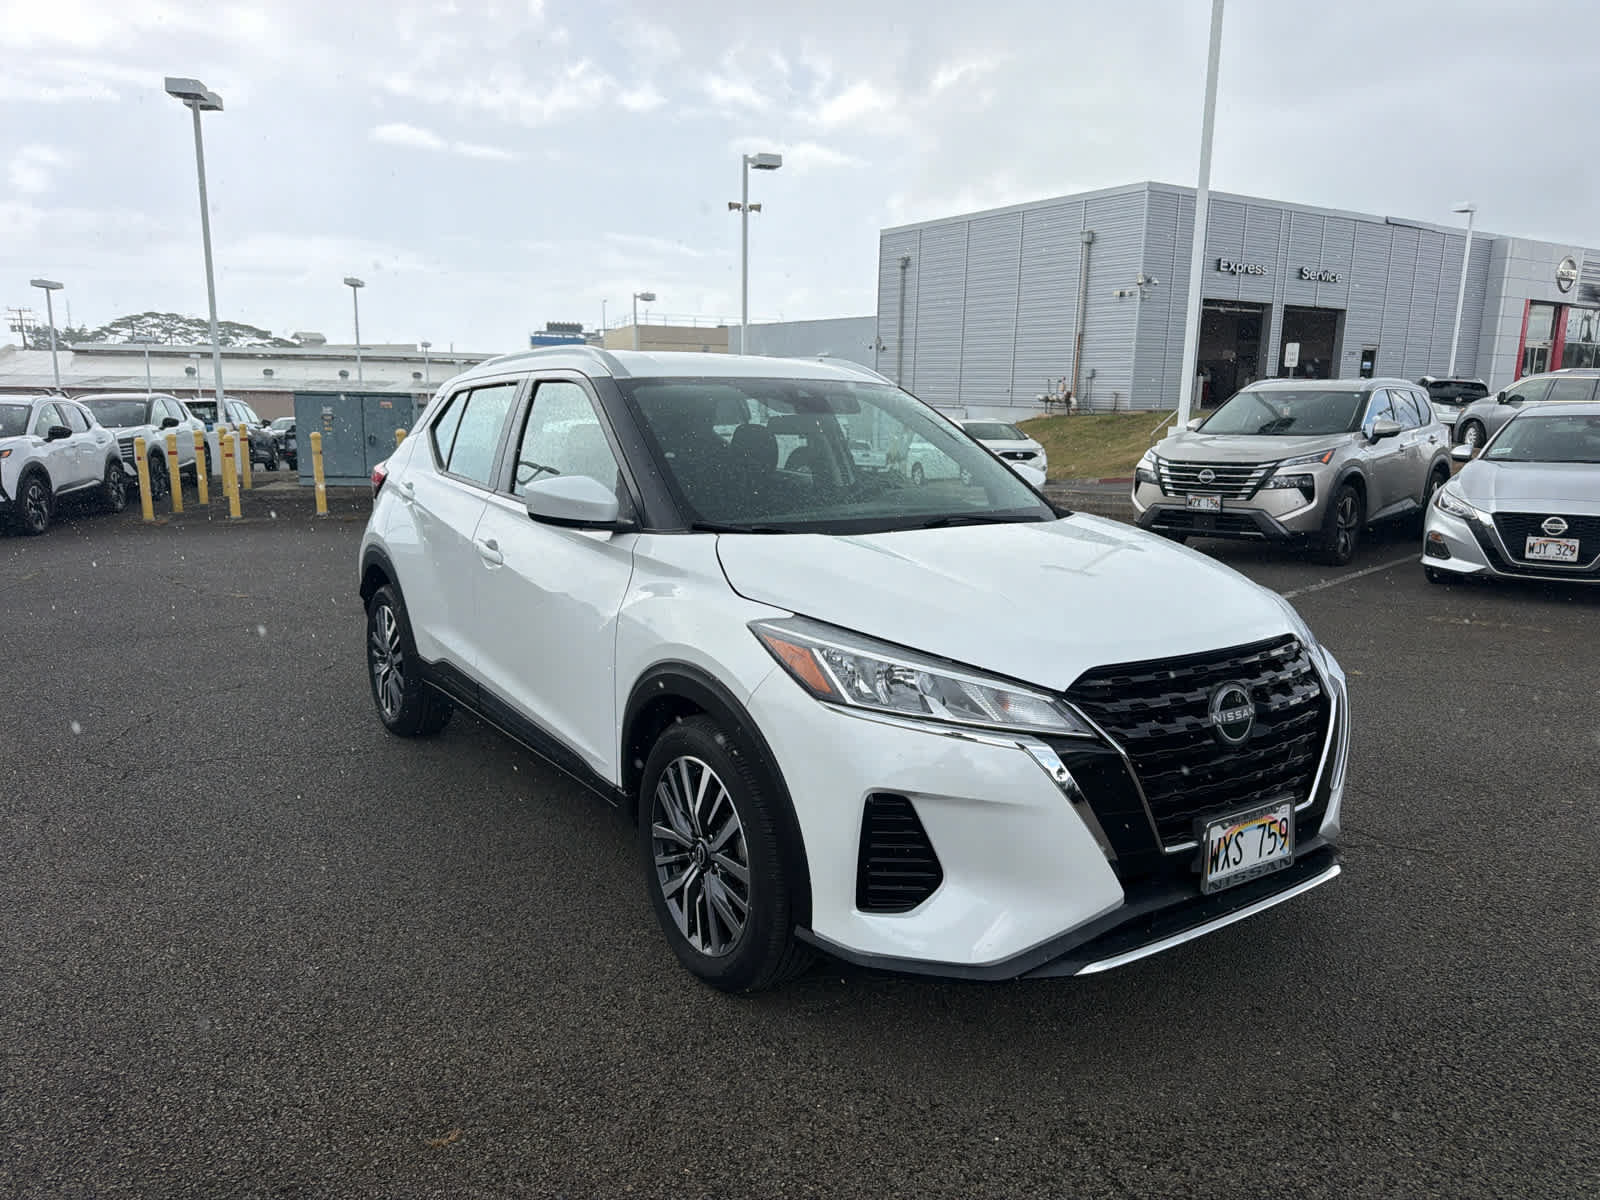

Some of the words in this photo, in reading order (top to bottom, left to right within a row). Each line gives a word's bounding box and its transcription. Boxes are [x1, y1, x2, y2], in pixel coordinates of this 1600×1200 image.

[1218, 257, 1269, 276] Express
[1301, 265, 1344, 283] Service
[1528, 542, 1549, 555] WJY
[1555, 543, 1577, 557] 329
[1212, 707, 1255, 724] NISSAN
[1209, 831, 1244, 875] WXS
[1257, 817, 1288, 858] 759
